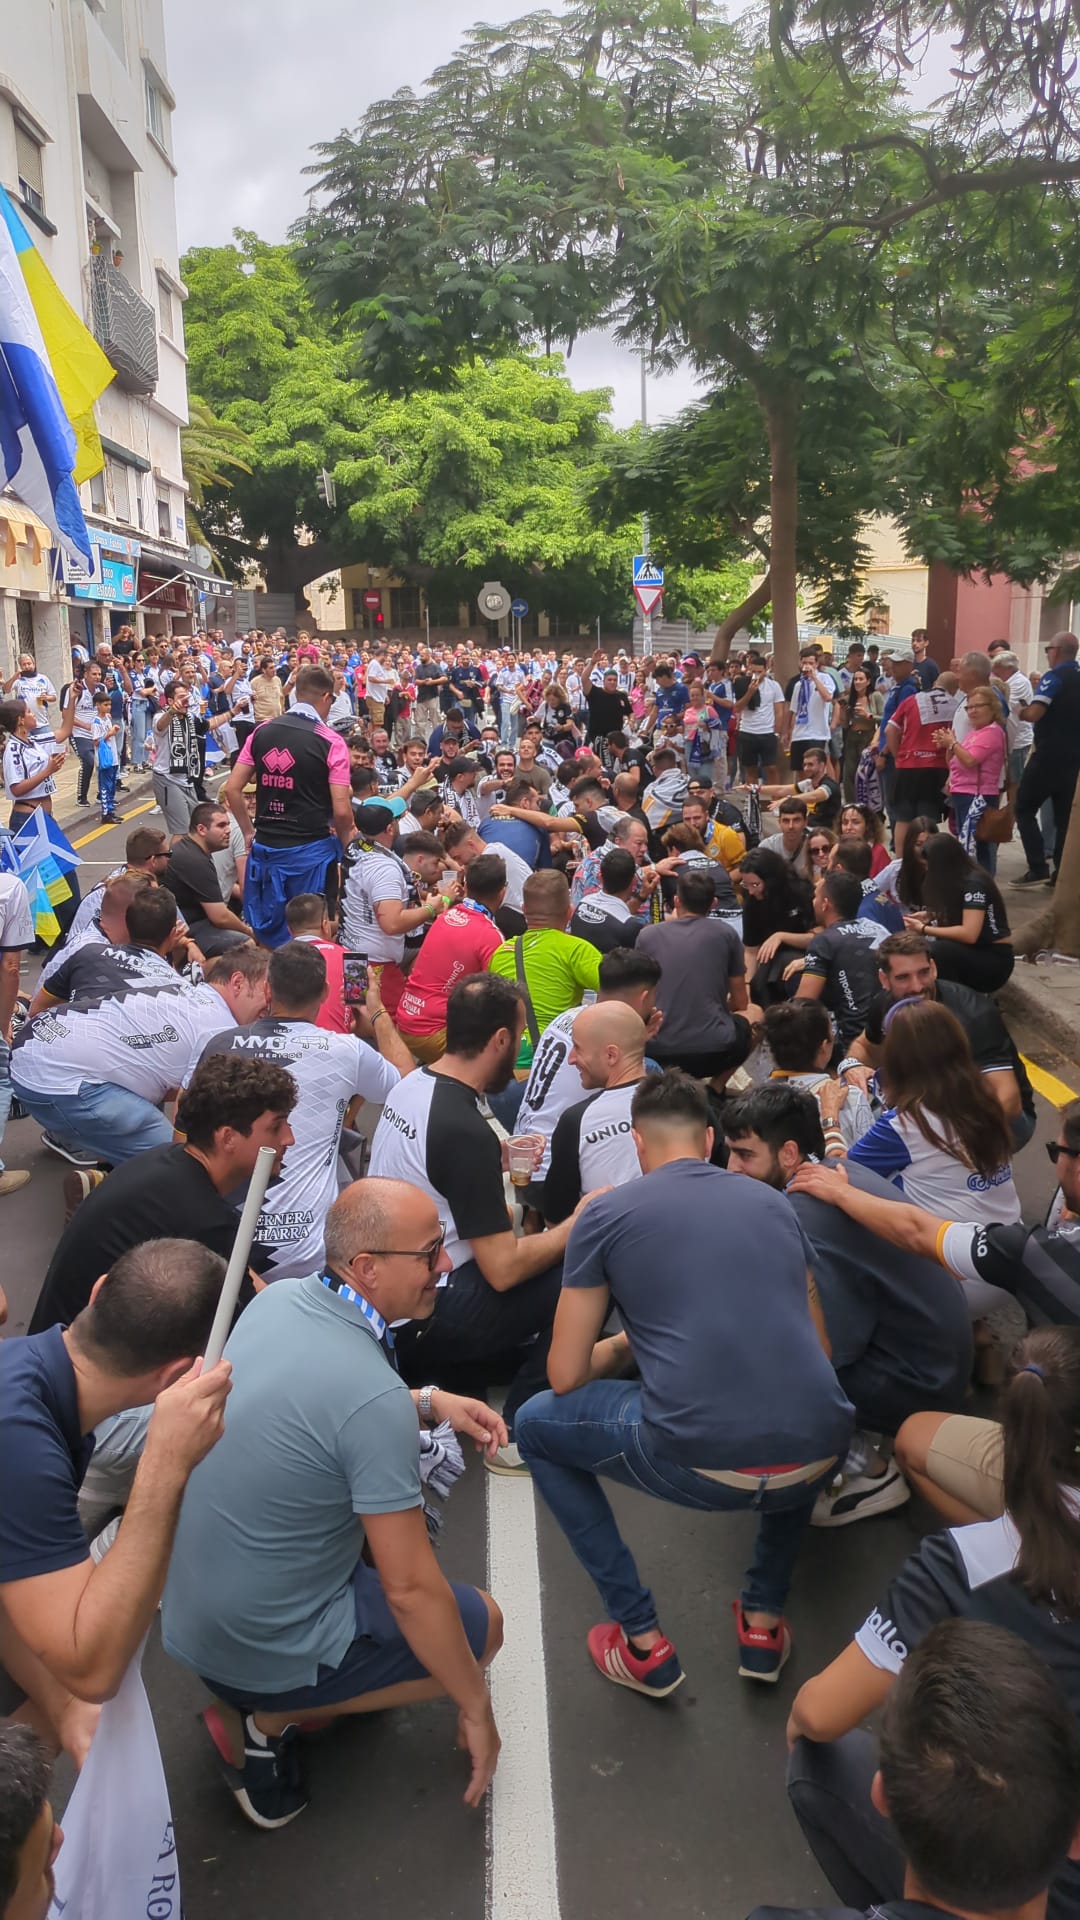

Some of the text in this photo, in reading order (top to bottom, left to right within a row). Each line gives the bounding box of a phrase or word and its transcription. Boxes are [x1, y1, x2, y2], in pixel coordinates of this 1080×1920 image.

[262, 773, 294, 790] errea
[231, 1035, 286, 1050] MMG
[525, 1036, 567, 1111] 19
[585, 1121, 631, 1144] UNIO
[257, 1211, 314, 1226] ERNERA
[749, 1633, 768, 1641] adidas
